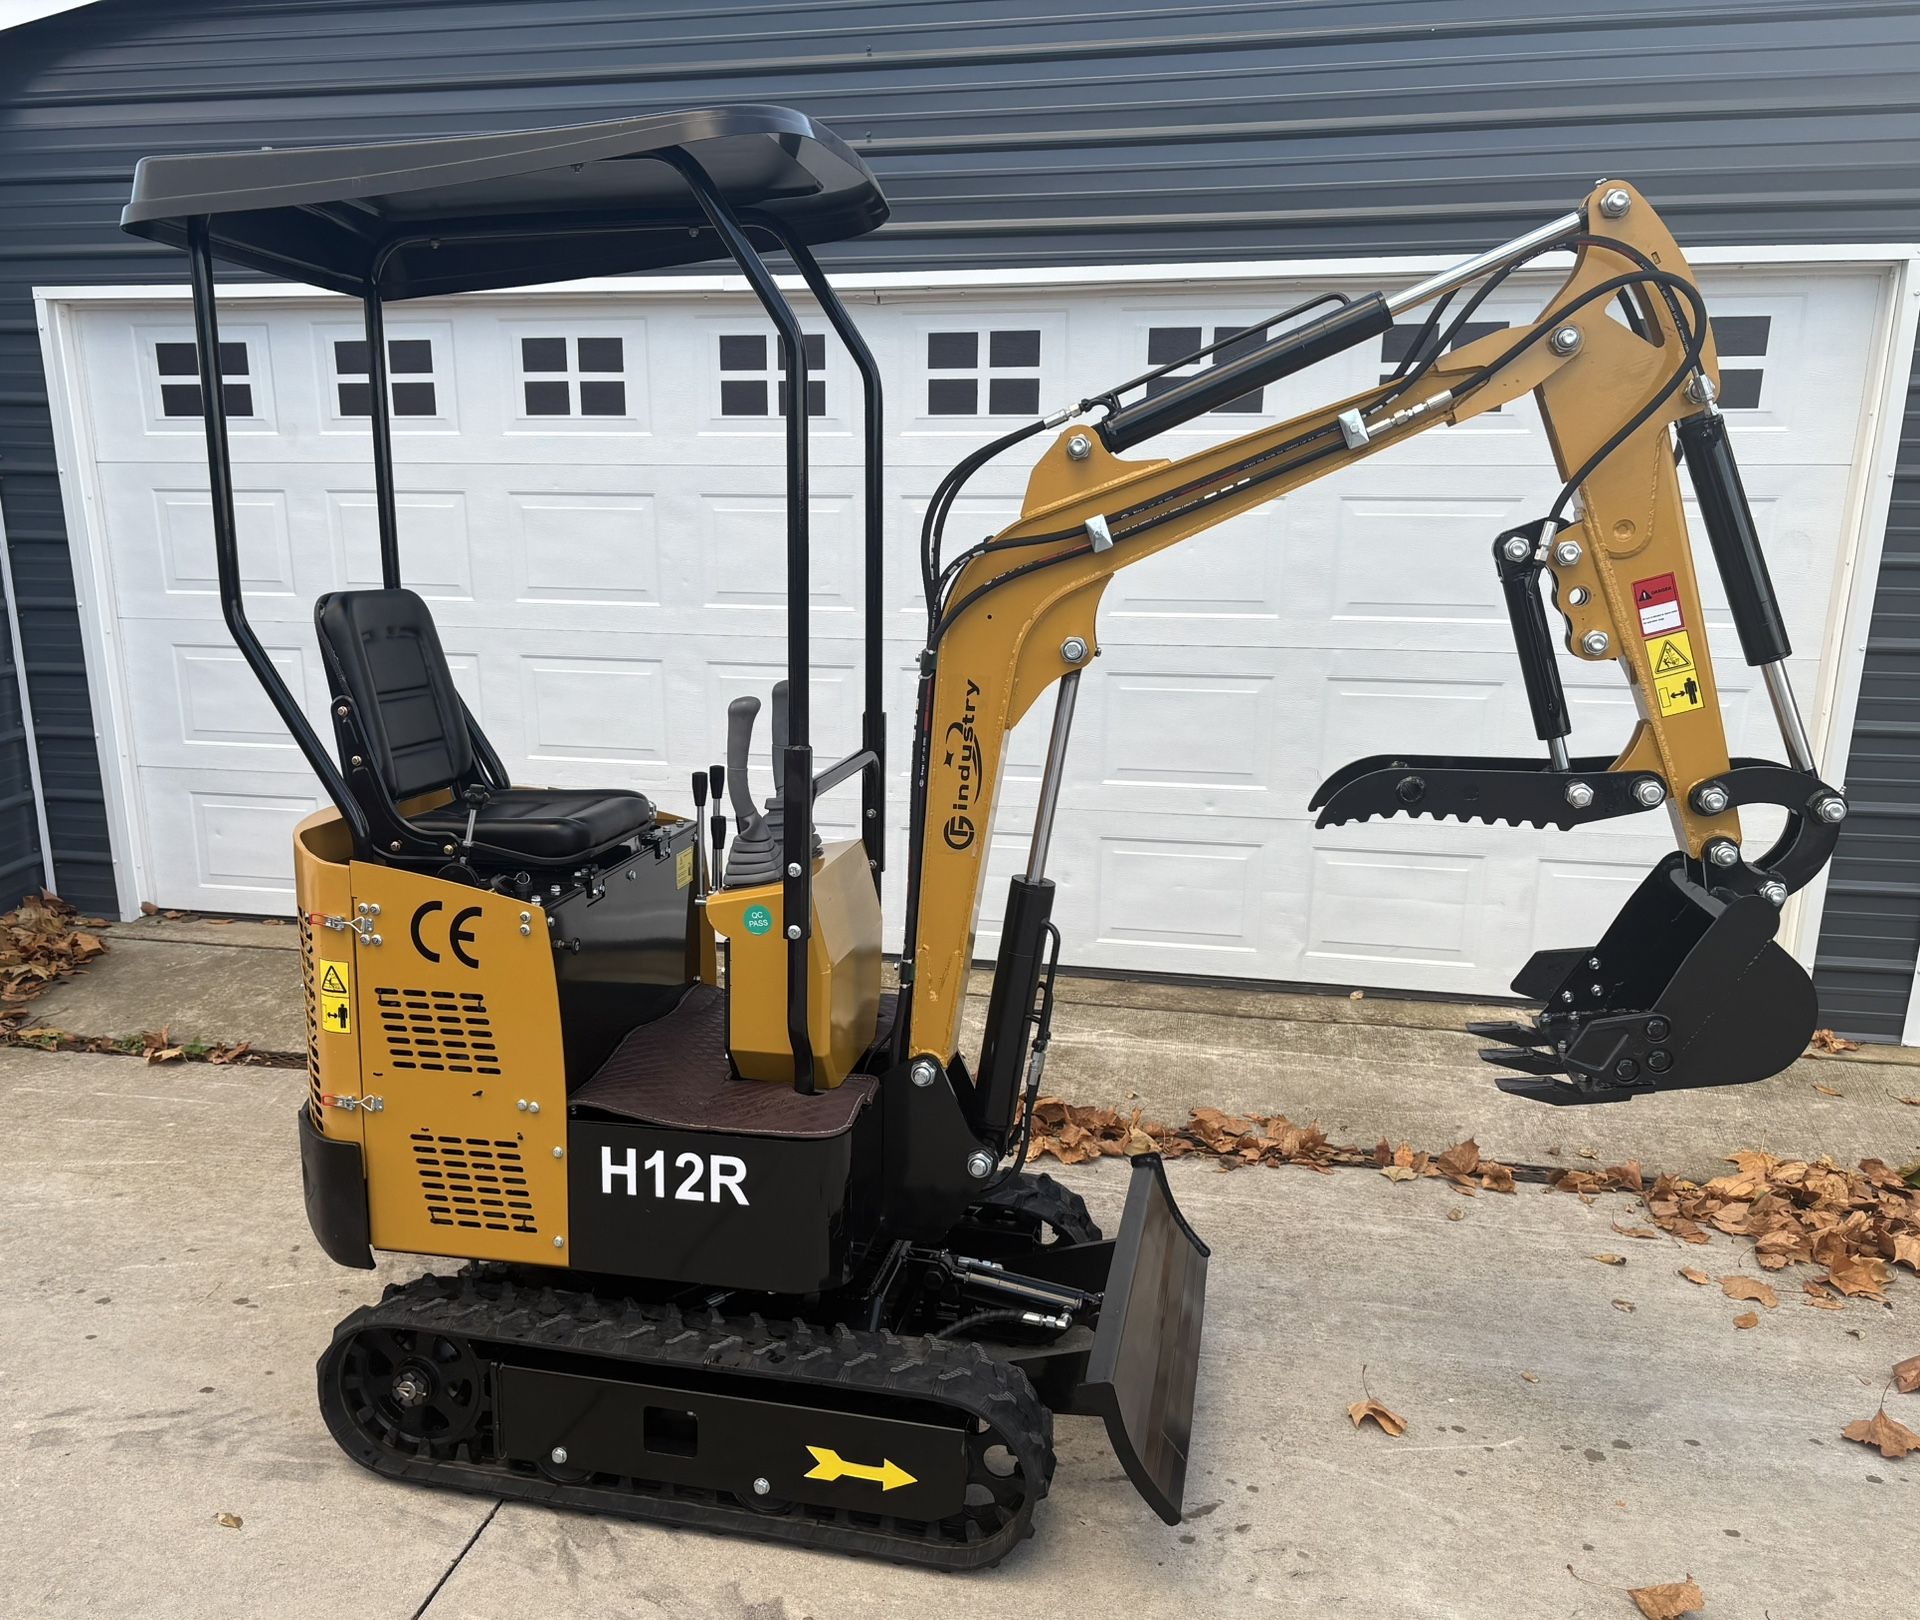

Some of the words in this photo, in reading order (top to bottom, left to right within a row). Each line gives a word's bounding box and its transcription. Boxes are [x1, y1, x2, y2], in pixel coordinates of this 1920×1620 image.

[748, 919, 769, 927] PASS
[751, 911, 763, 919] QC
[411, 900, 482, 968] CE
[601, 1146, 750, 1206] H12R
